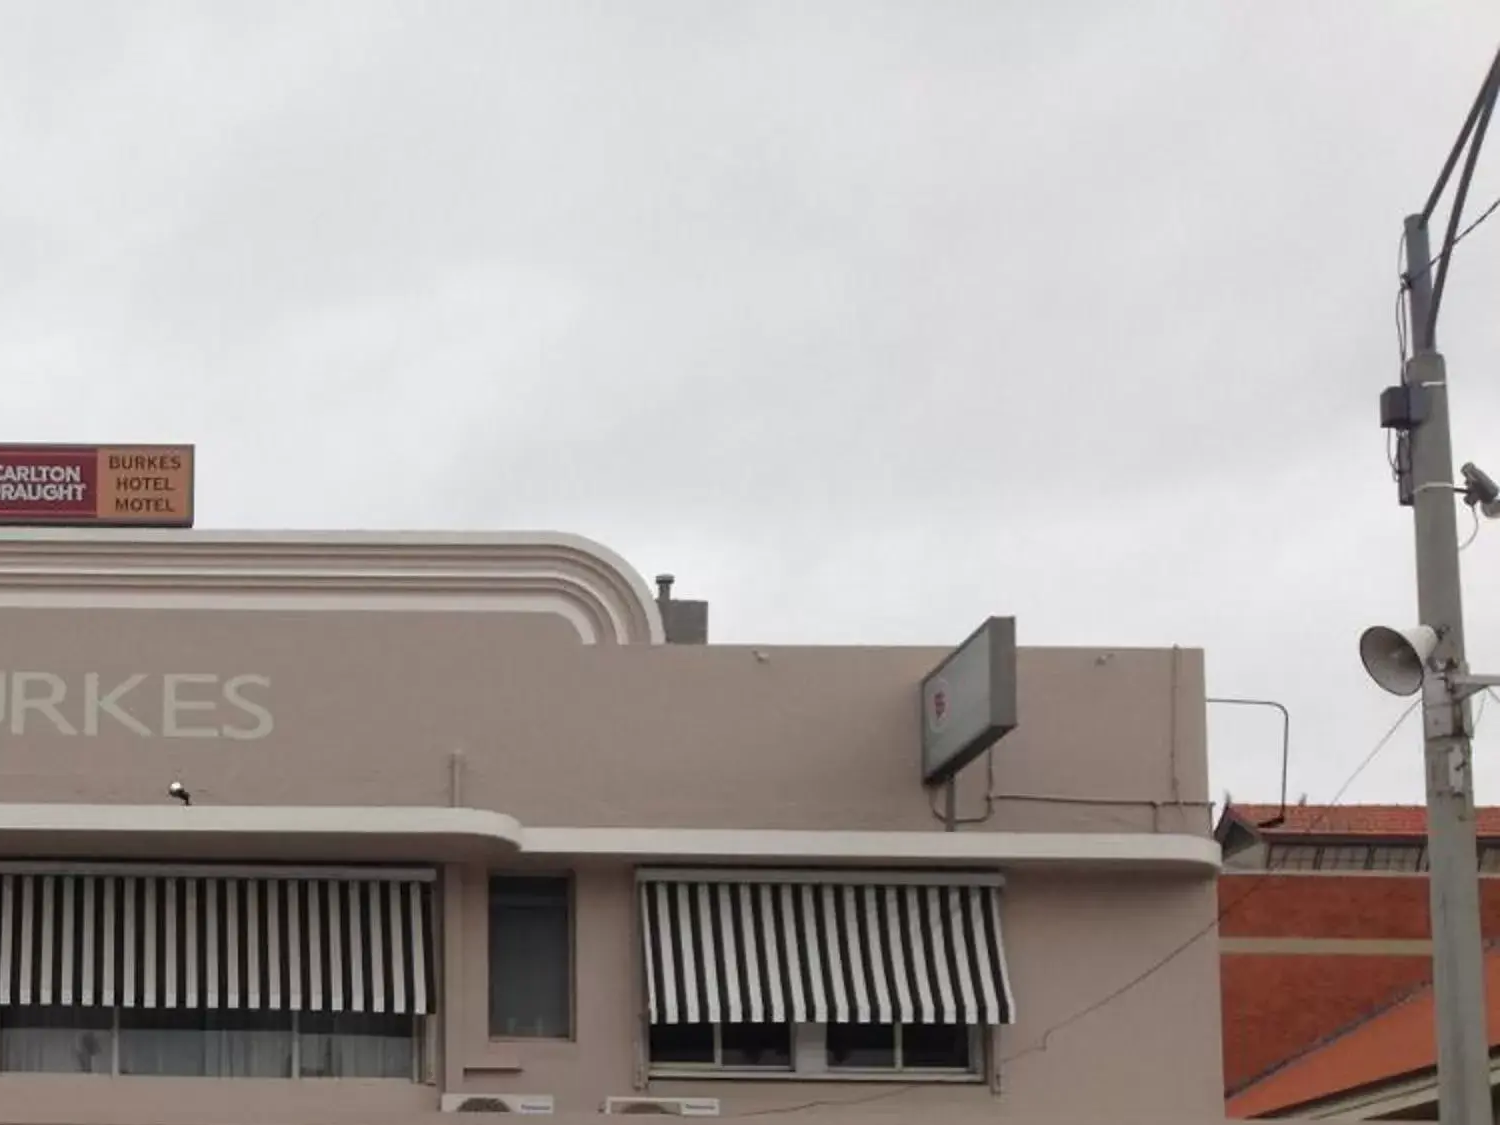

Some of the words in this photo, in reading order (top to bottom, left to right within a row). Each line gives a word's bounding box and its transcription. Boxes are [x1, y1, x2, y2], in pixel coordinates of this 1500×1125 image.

[108, 454, 182, 471] BURKES
[116, 475, 175, 492] HOTEL
[115, 497, 175, 513] MOTEL
